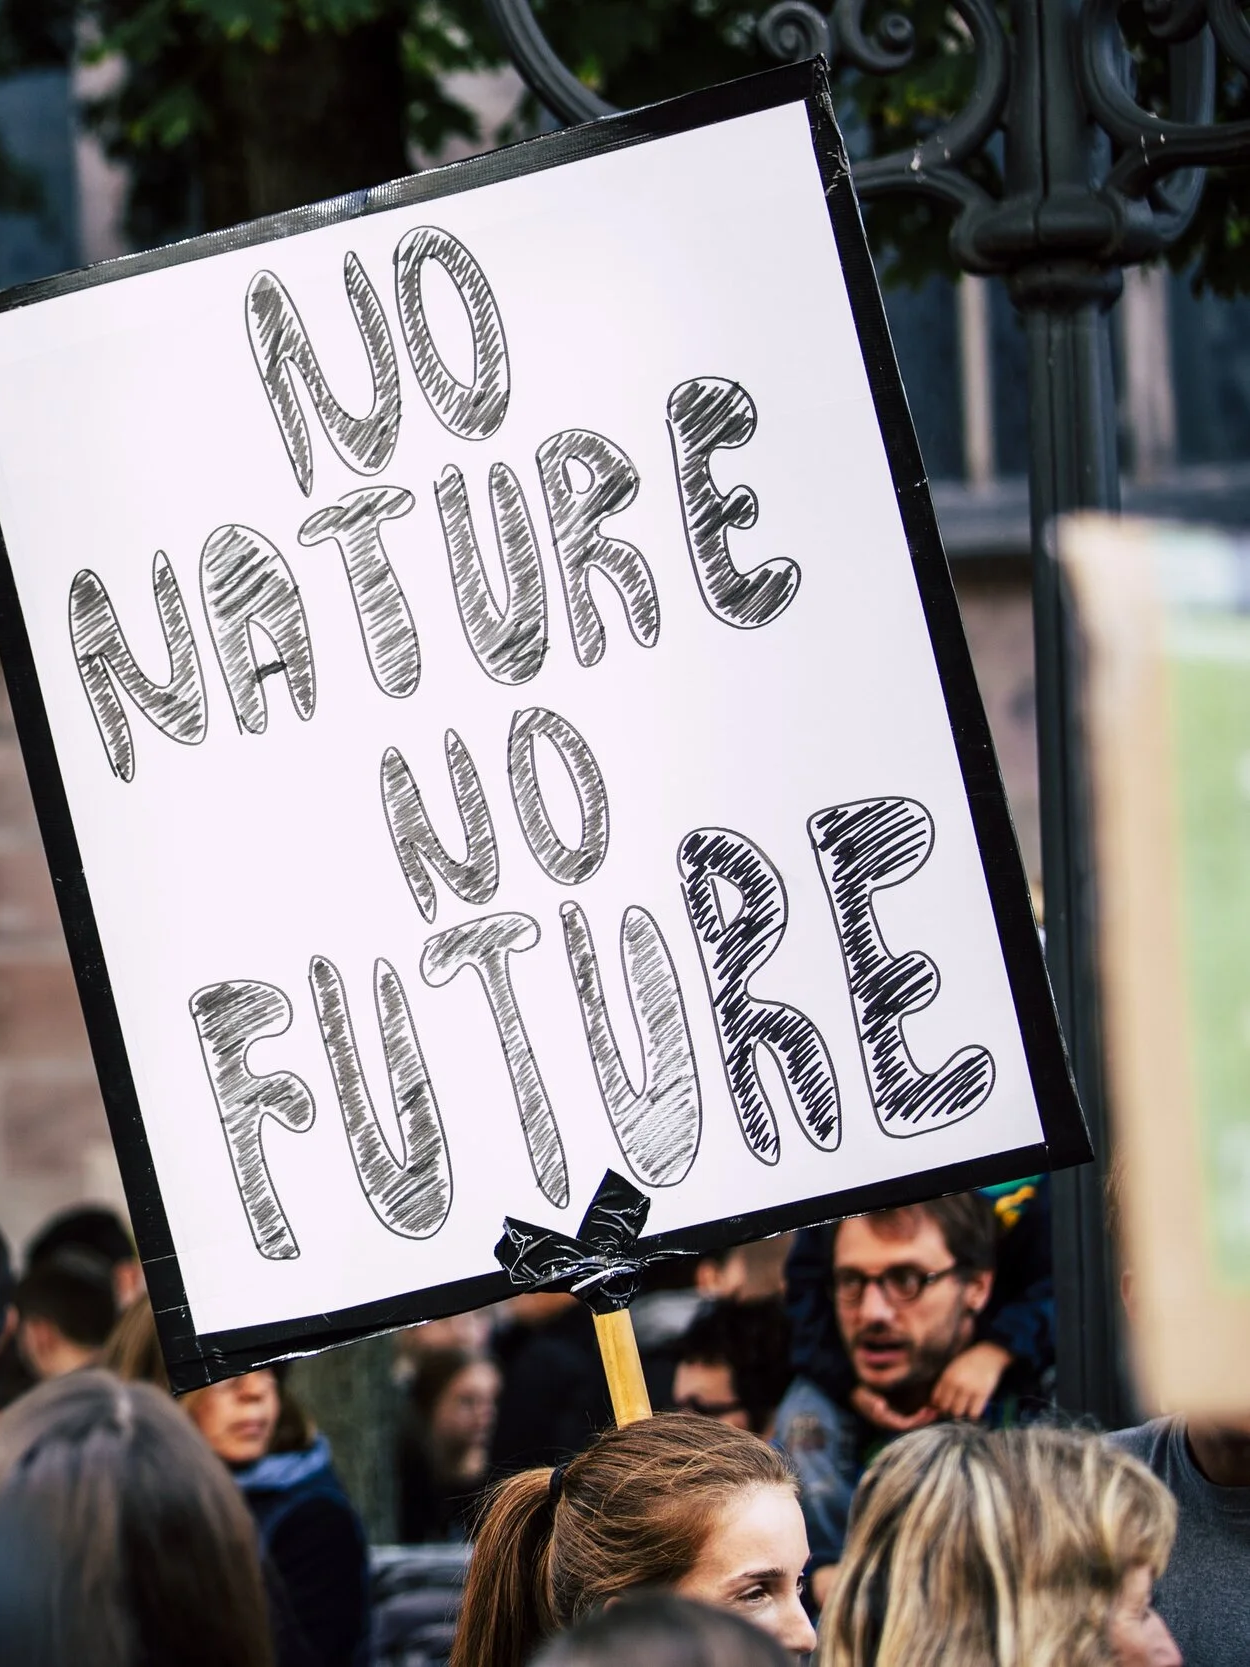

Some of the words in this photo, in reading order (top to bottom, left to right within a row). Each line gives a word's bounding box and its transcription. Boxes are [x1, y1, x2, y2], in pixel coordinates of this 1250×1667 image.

[245, 226, 510, 498] NO
[68, 376, 801, 783] NATURE
[380, 707, 610, 924] NO
[189, 796, 996, 1260] FUTURE
